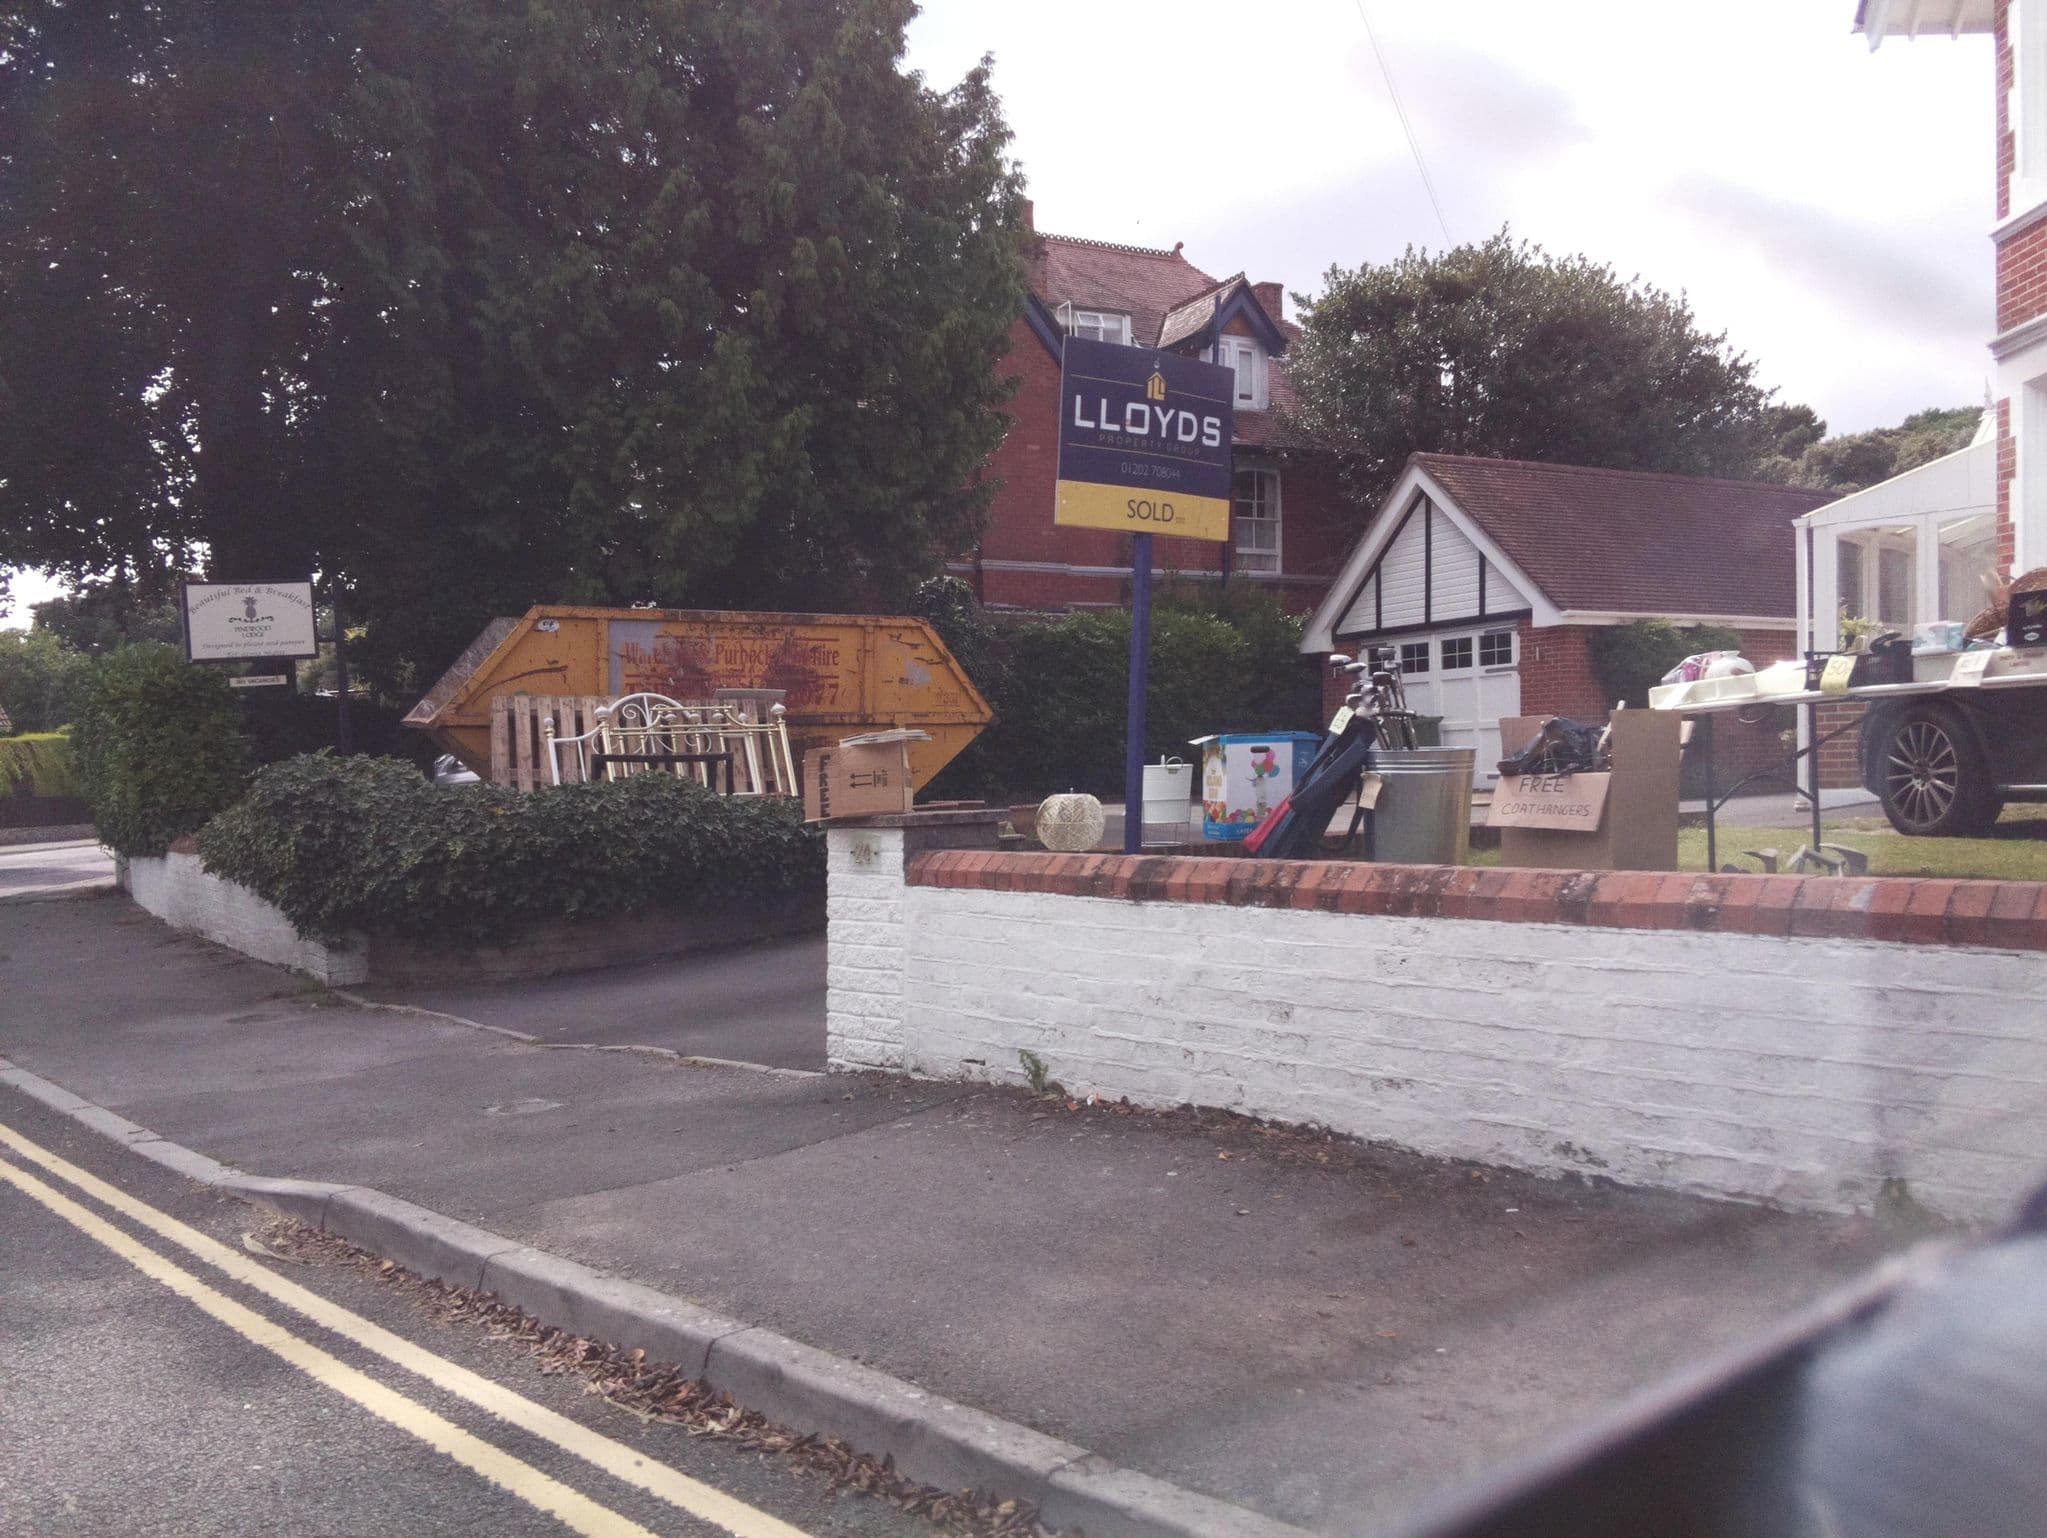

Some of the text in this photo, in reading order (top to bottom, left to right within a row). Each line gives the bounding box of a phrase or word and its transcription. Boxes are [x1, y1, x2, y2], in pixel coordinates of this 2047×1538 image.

[1074, 394, 1221, 447] LLOYDS
[1098, 433, 1201, 456] PROPERTY GROUP
[1121, 461, 1149, 476] 01202
[1127, 499, 1174, 522] SOLD
[1519, 777, 1565, 794] FREE
[1501, 801, 1592, 817] COATHANGERS
